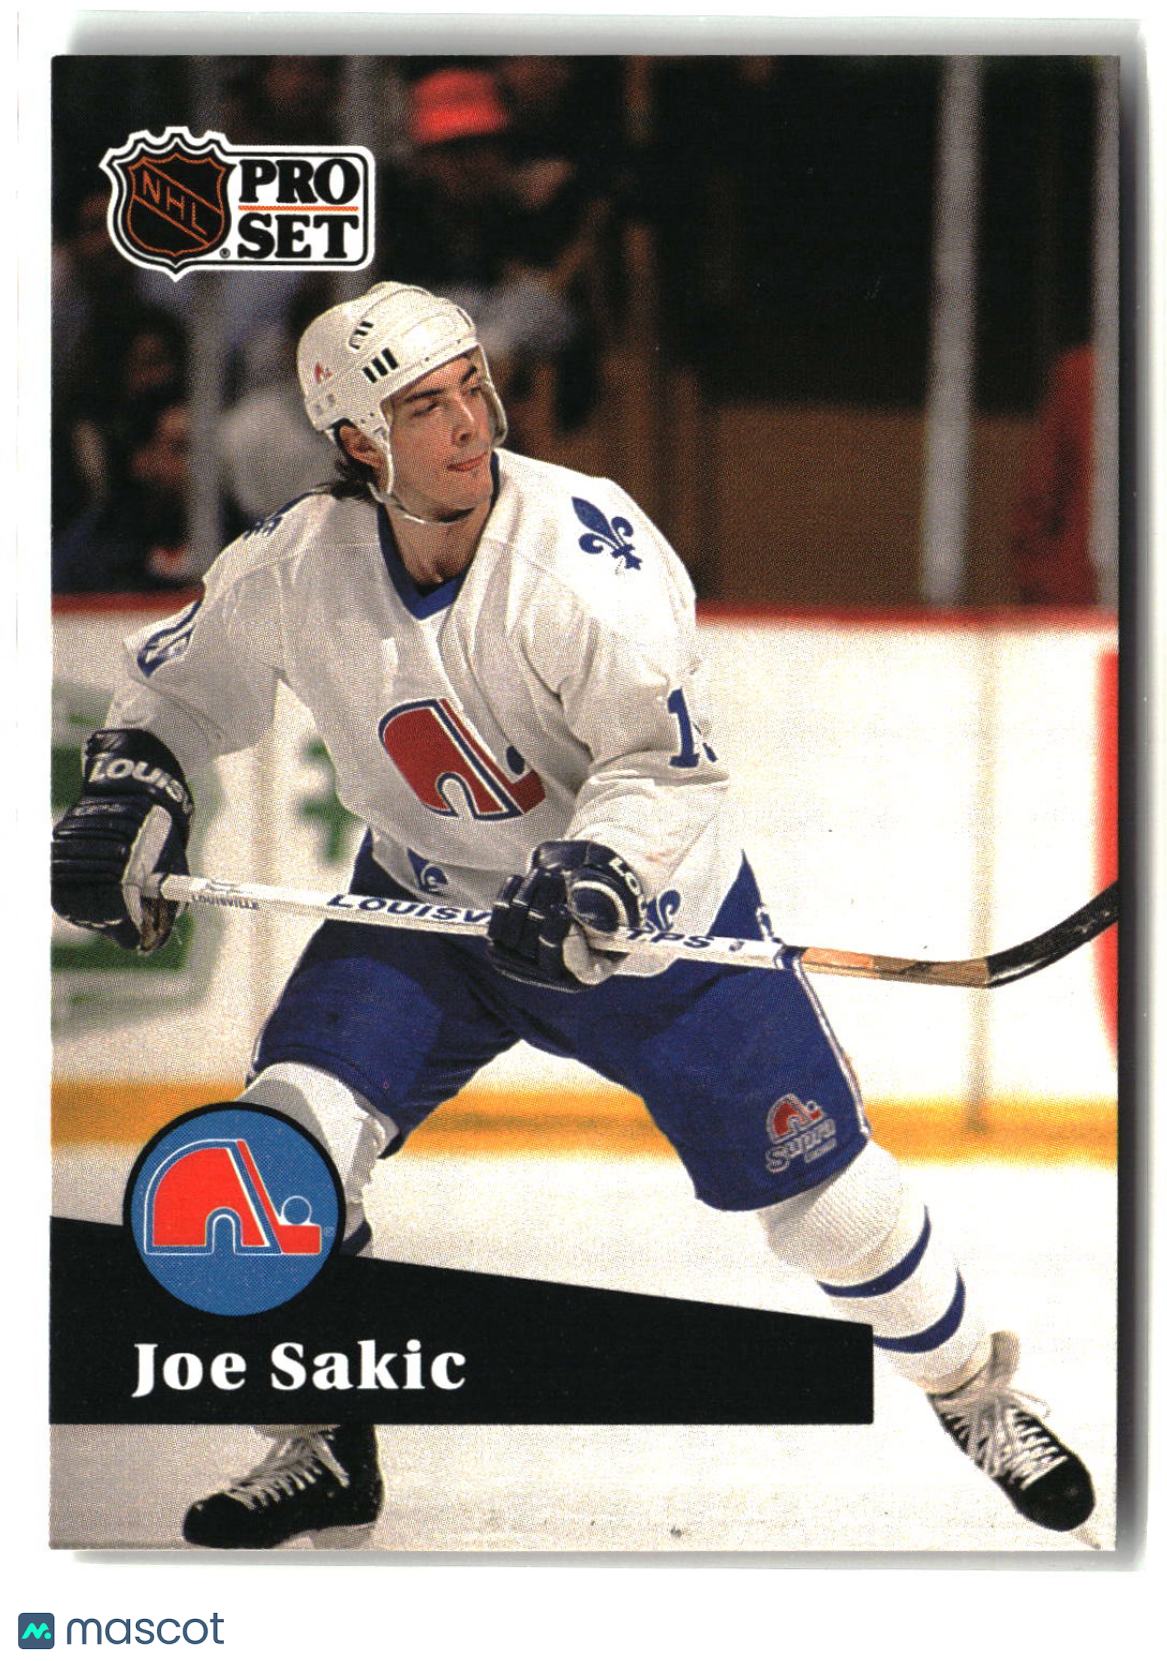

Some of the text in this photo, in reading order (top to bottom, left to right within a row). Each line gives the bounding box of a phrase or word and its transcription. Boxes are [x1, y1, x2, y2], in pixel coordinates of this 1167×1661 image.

[141, 169, 208, 236] NHL
[238, 158, 361, 205] PRO
[237, 212, 360, 259] SET
[666, 686, 719, 769] 1
[131, 1339, 466, 1398] Joe Sakic
